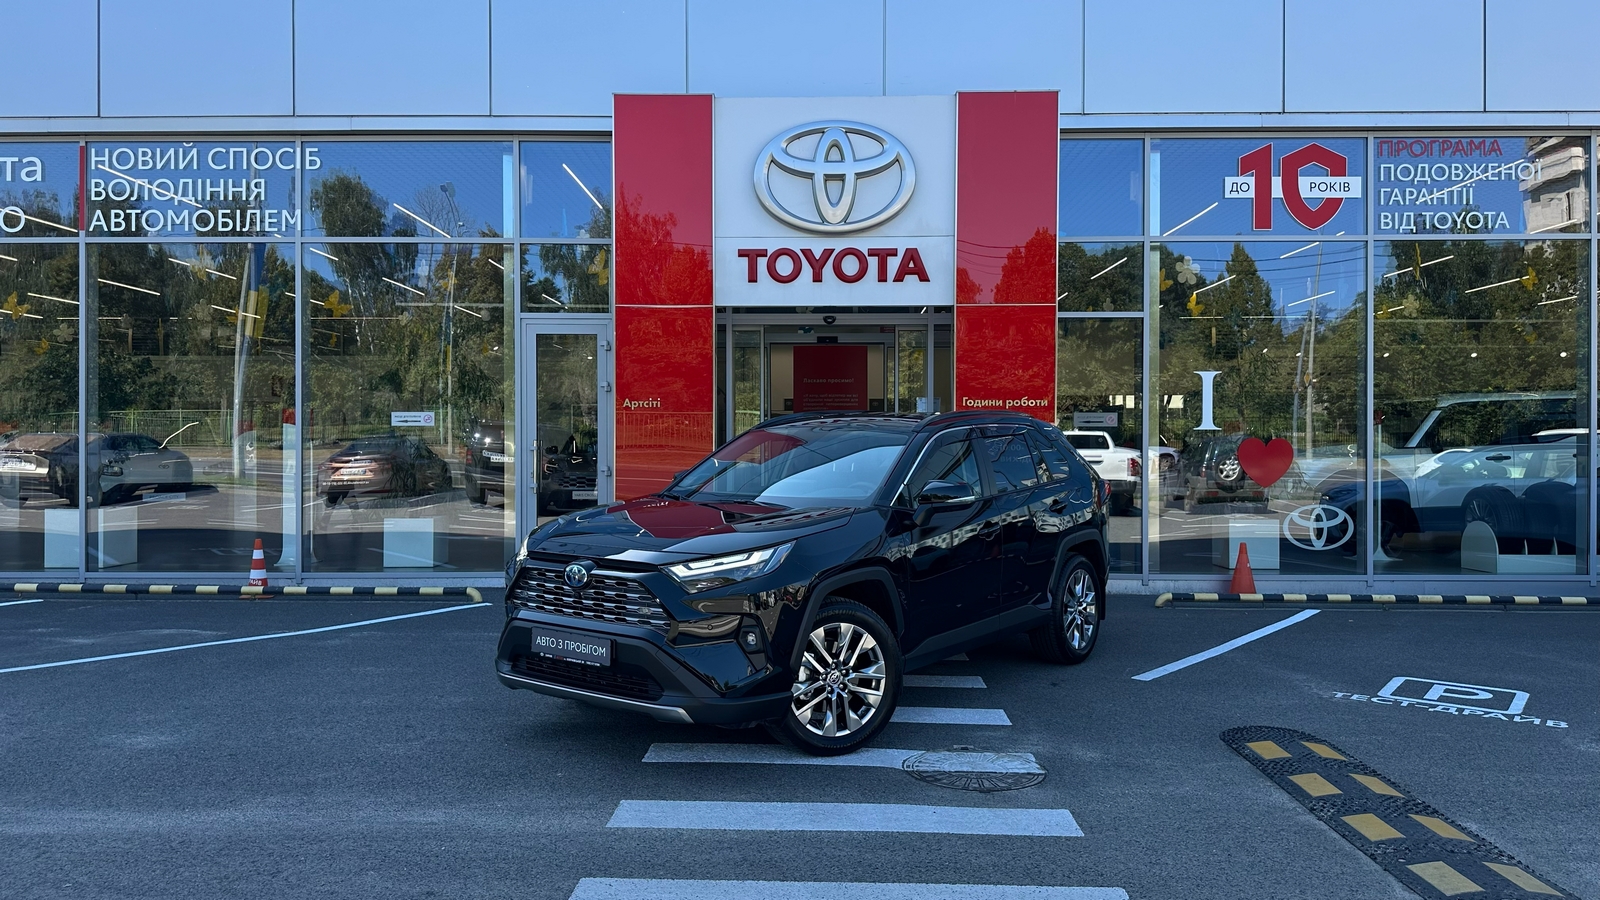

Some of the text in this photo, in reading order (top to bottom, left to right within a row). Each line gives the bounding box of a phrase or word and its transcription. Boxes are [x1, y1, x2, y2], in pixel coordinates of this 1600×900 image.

[90, 142, 321, 170] НОВИЙ СПОСІБ
[1378, 139, 1503, 157] ПРОГРАМА
[1380, 158, 1543, 185] ПОДОВЖЕНОЇ
[90, 178, 266, 205] ВОЛОДІННЯ
[1229, 182, 1250, 194] ДО
[1309, 182, 1351, 193] РОКІВ
[1380, 183, 1476, 205] ГАРАНТІЇ
[88, 209, 302, 232] АВТОМОБІЛЕМ
[1380, 211, 1510, 233] ВІД TOYOTA
[738, 247, 931, 284] TOYOTA
[622, 397, 661, 410] Артсіті
[962, 396, 1048, 409] Години роботи
[536, 636, 556, 648] АВТО
[564, 640, 606, 657] ПРОБІГОМ
[1423, 683, 1494, 701] P
[1332, 691, 1569, 728] ТЕСТ-ДРАЙВ
